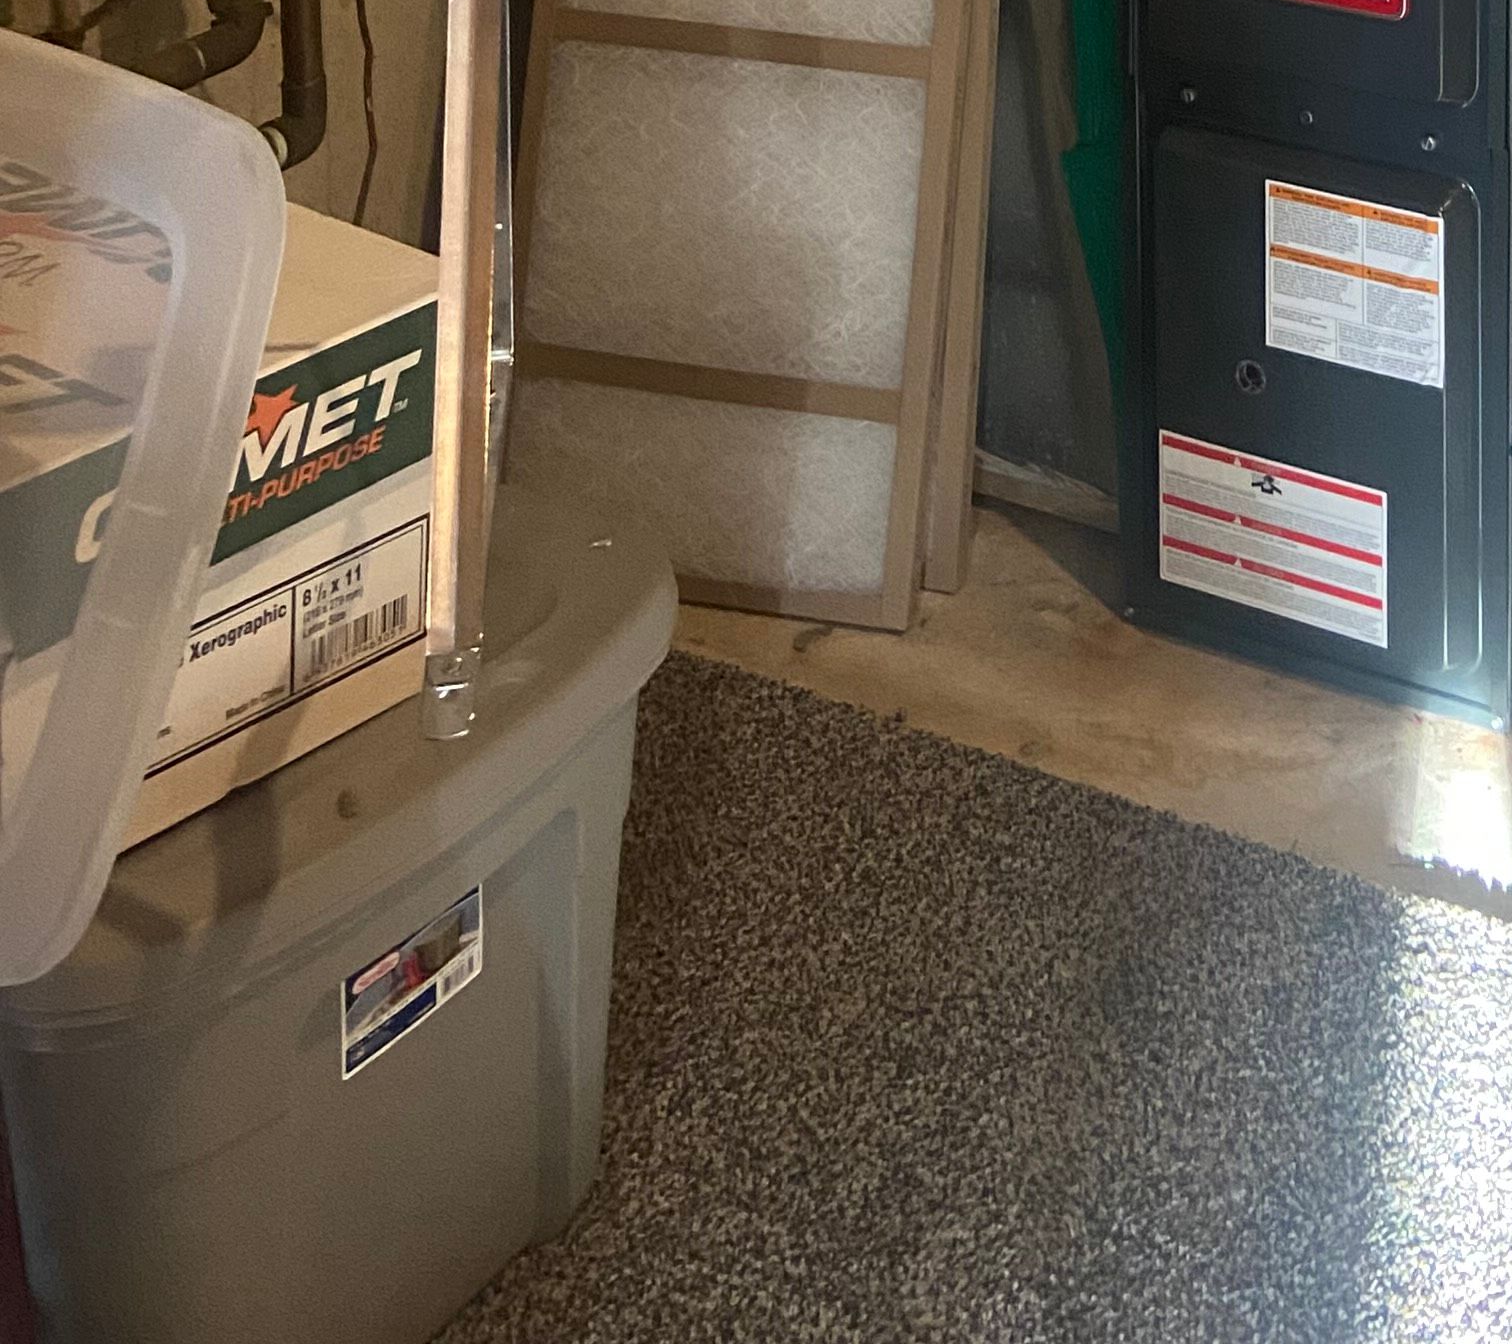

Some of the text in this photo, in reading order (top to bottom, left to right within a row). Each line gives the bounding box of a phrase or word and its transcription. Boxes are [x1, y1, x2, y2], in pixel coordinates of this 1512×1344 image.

[302, 589, 311, 607] 8
[345, 564, 361, 586] 11
[189, 603, 287, 662] Xerographic
